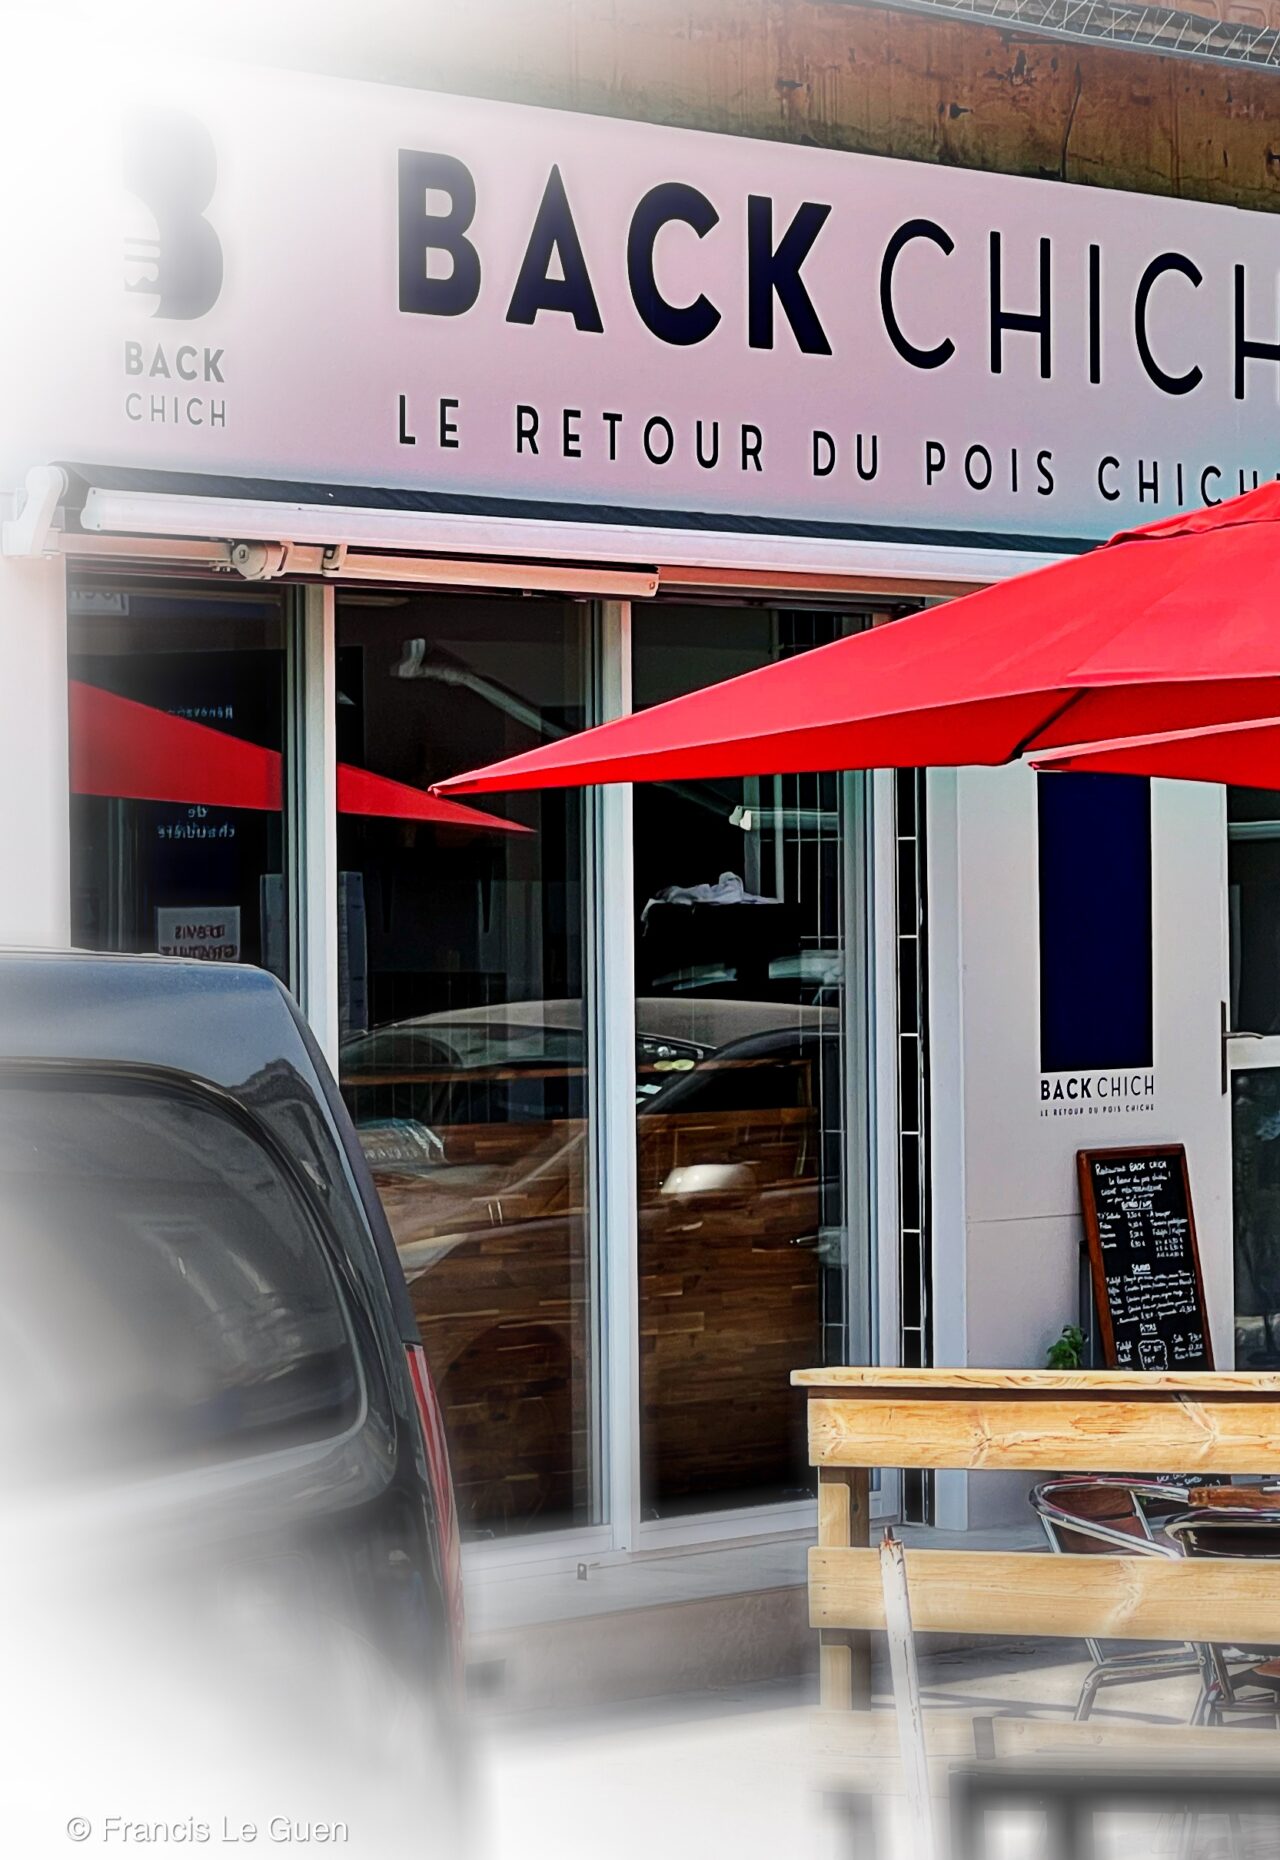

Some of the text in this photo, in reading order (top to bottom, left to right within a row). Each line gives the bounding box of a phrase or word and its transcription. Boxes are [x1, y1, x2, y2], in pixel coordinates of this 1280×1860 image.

[398, 147, 833, 356] BACK
[125, 341, 225, 383] BACK
[125, 393, 226, 428] CHICH
[399, 394, 459, 449] LE
[516, 404, 763, 473] RETOUR
[813, 430, 879, 481] DU
[925, 441, 1055, 496] POIS
[1041, 1075, 1154, 1101] BACK CHICH
[1041, 1109, 1048, 1117] LE
[1053, 1107, 1084, 1116] RETOUR
[1103, 1105, 1121, 1113] POIS
[1126, 1103, 1154, 1112] CHICHE
